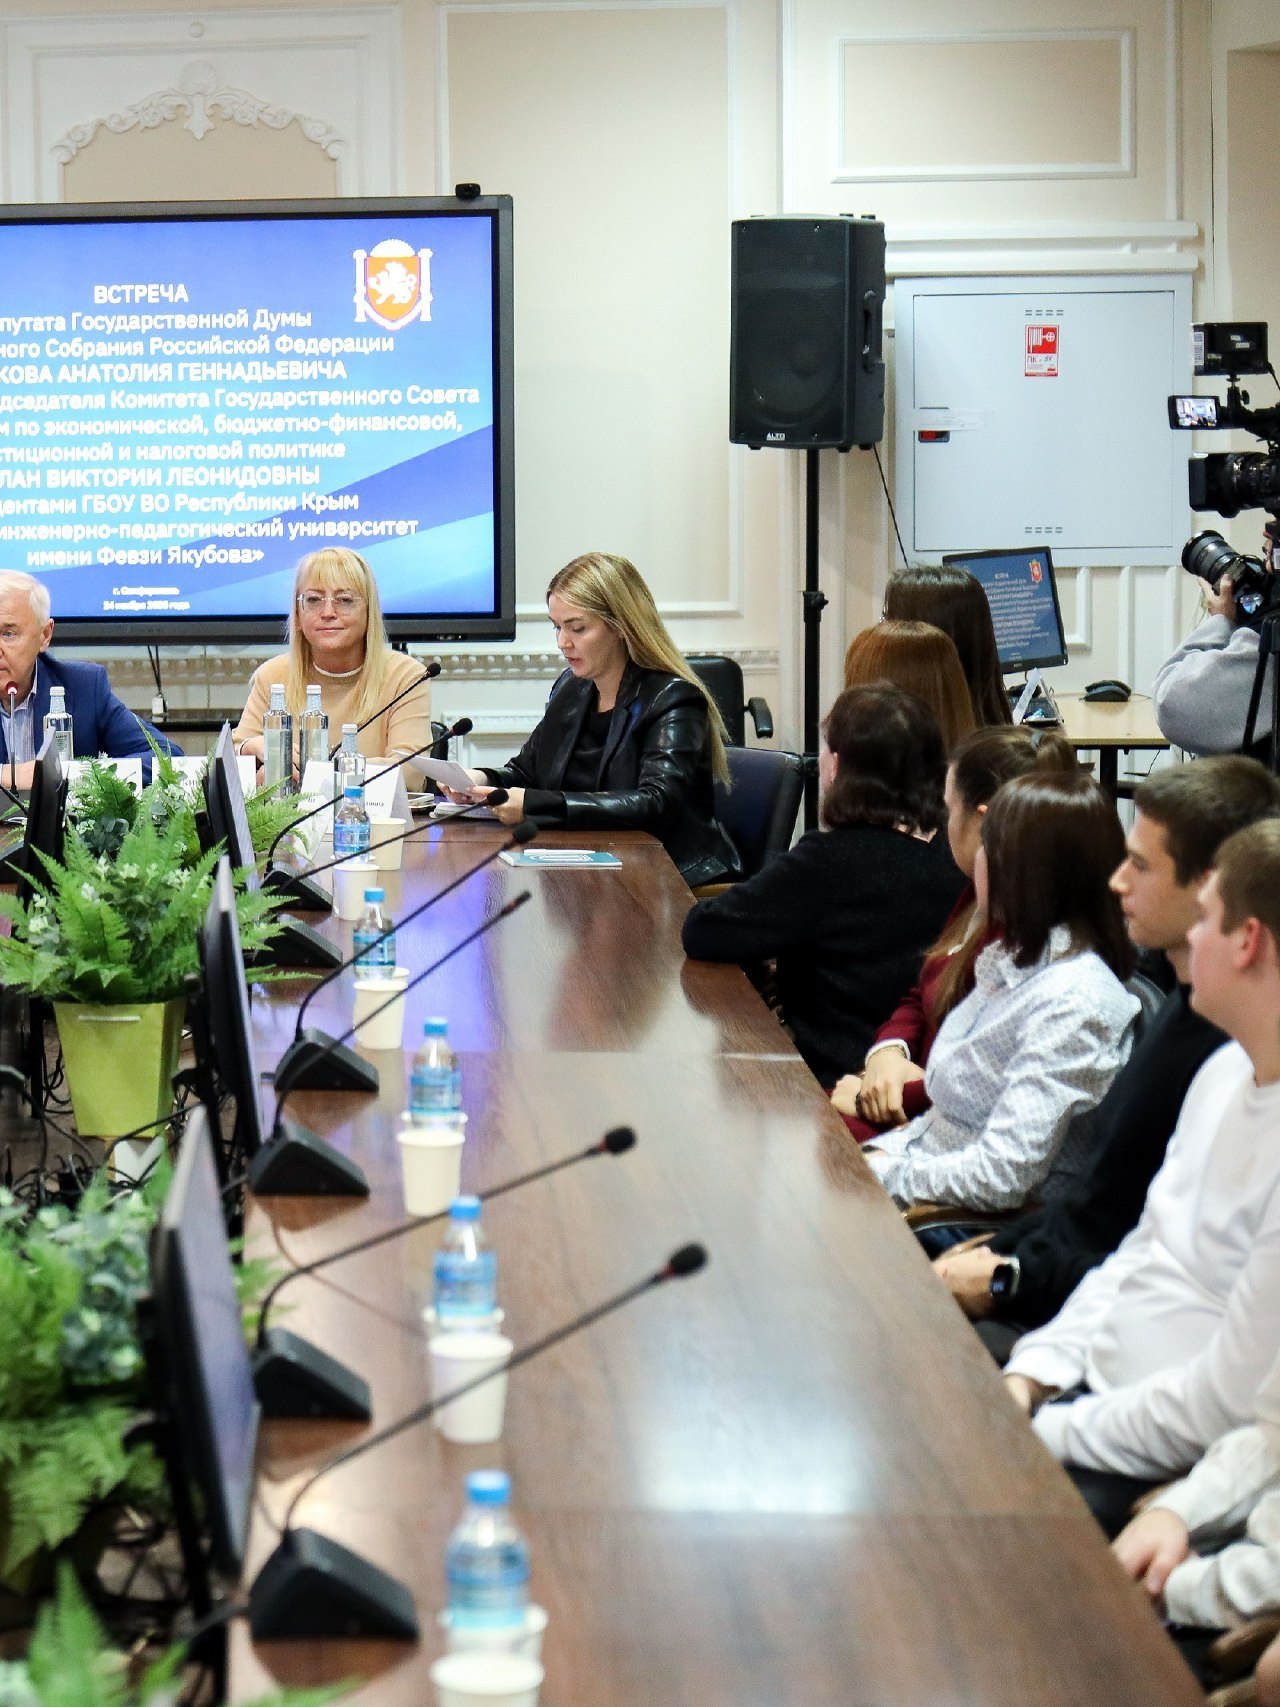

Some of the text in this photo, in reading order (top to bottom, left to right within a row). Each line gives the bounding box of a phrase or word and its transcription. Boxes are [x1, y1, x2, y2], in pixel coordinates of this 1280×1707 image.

[94, 283, 189, 304] ВСТРЕЧА
[71, 308, 249, 335] Государственной
[252, 308, 312, 332] Думы
[45, 337, 144, 361] Собрания
[149, 334, 270, 356] Российской
[274, 334, 394, 357] Федерации
[57, 362, 173, 383] АНАТОЛИЯ
[177, 360, 348, 384] ГЕННАДЬЕВИЧА
[110, 390, 210, 409] Комитета
[214, 388, 403, 411] Государственного
[406, 385, 480, 405] Совета
[14, 421, 41, 437] по
[43, 414, 209, 437] экономической,
[213, 410, 463, 436] бюджетно-финансовой,
[766, 432, 786, 441] ALTO
[118, 445, 131, 461] и
[136, 439, 244, 461] налоговой
[248, 442, 346, 459] политике
[46, 467, 162, 488] ВИКТОРИИ
[165, 465, 320, 489] ЛЕОНИДОВНЫ
[82, 493, 136, 514] ГБОУ
[140, 493, 170, 513] ВО
[174, 491, 297, 516] Республики
[301, 491, 359, 515] Крым
[287, 520, 419, 541] университет
[27, 544, 265, 568] имени Февзи Якубова»
